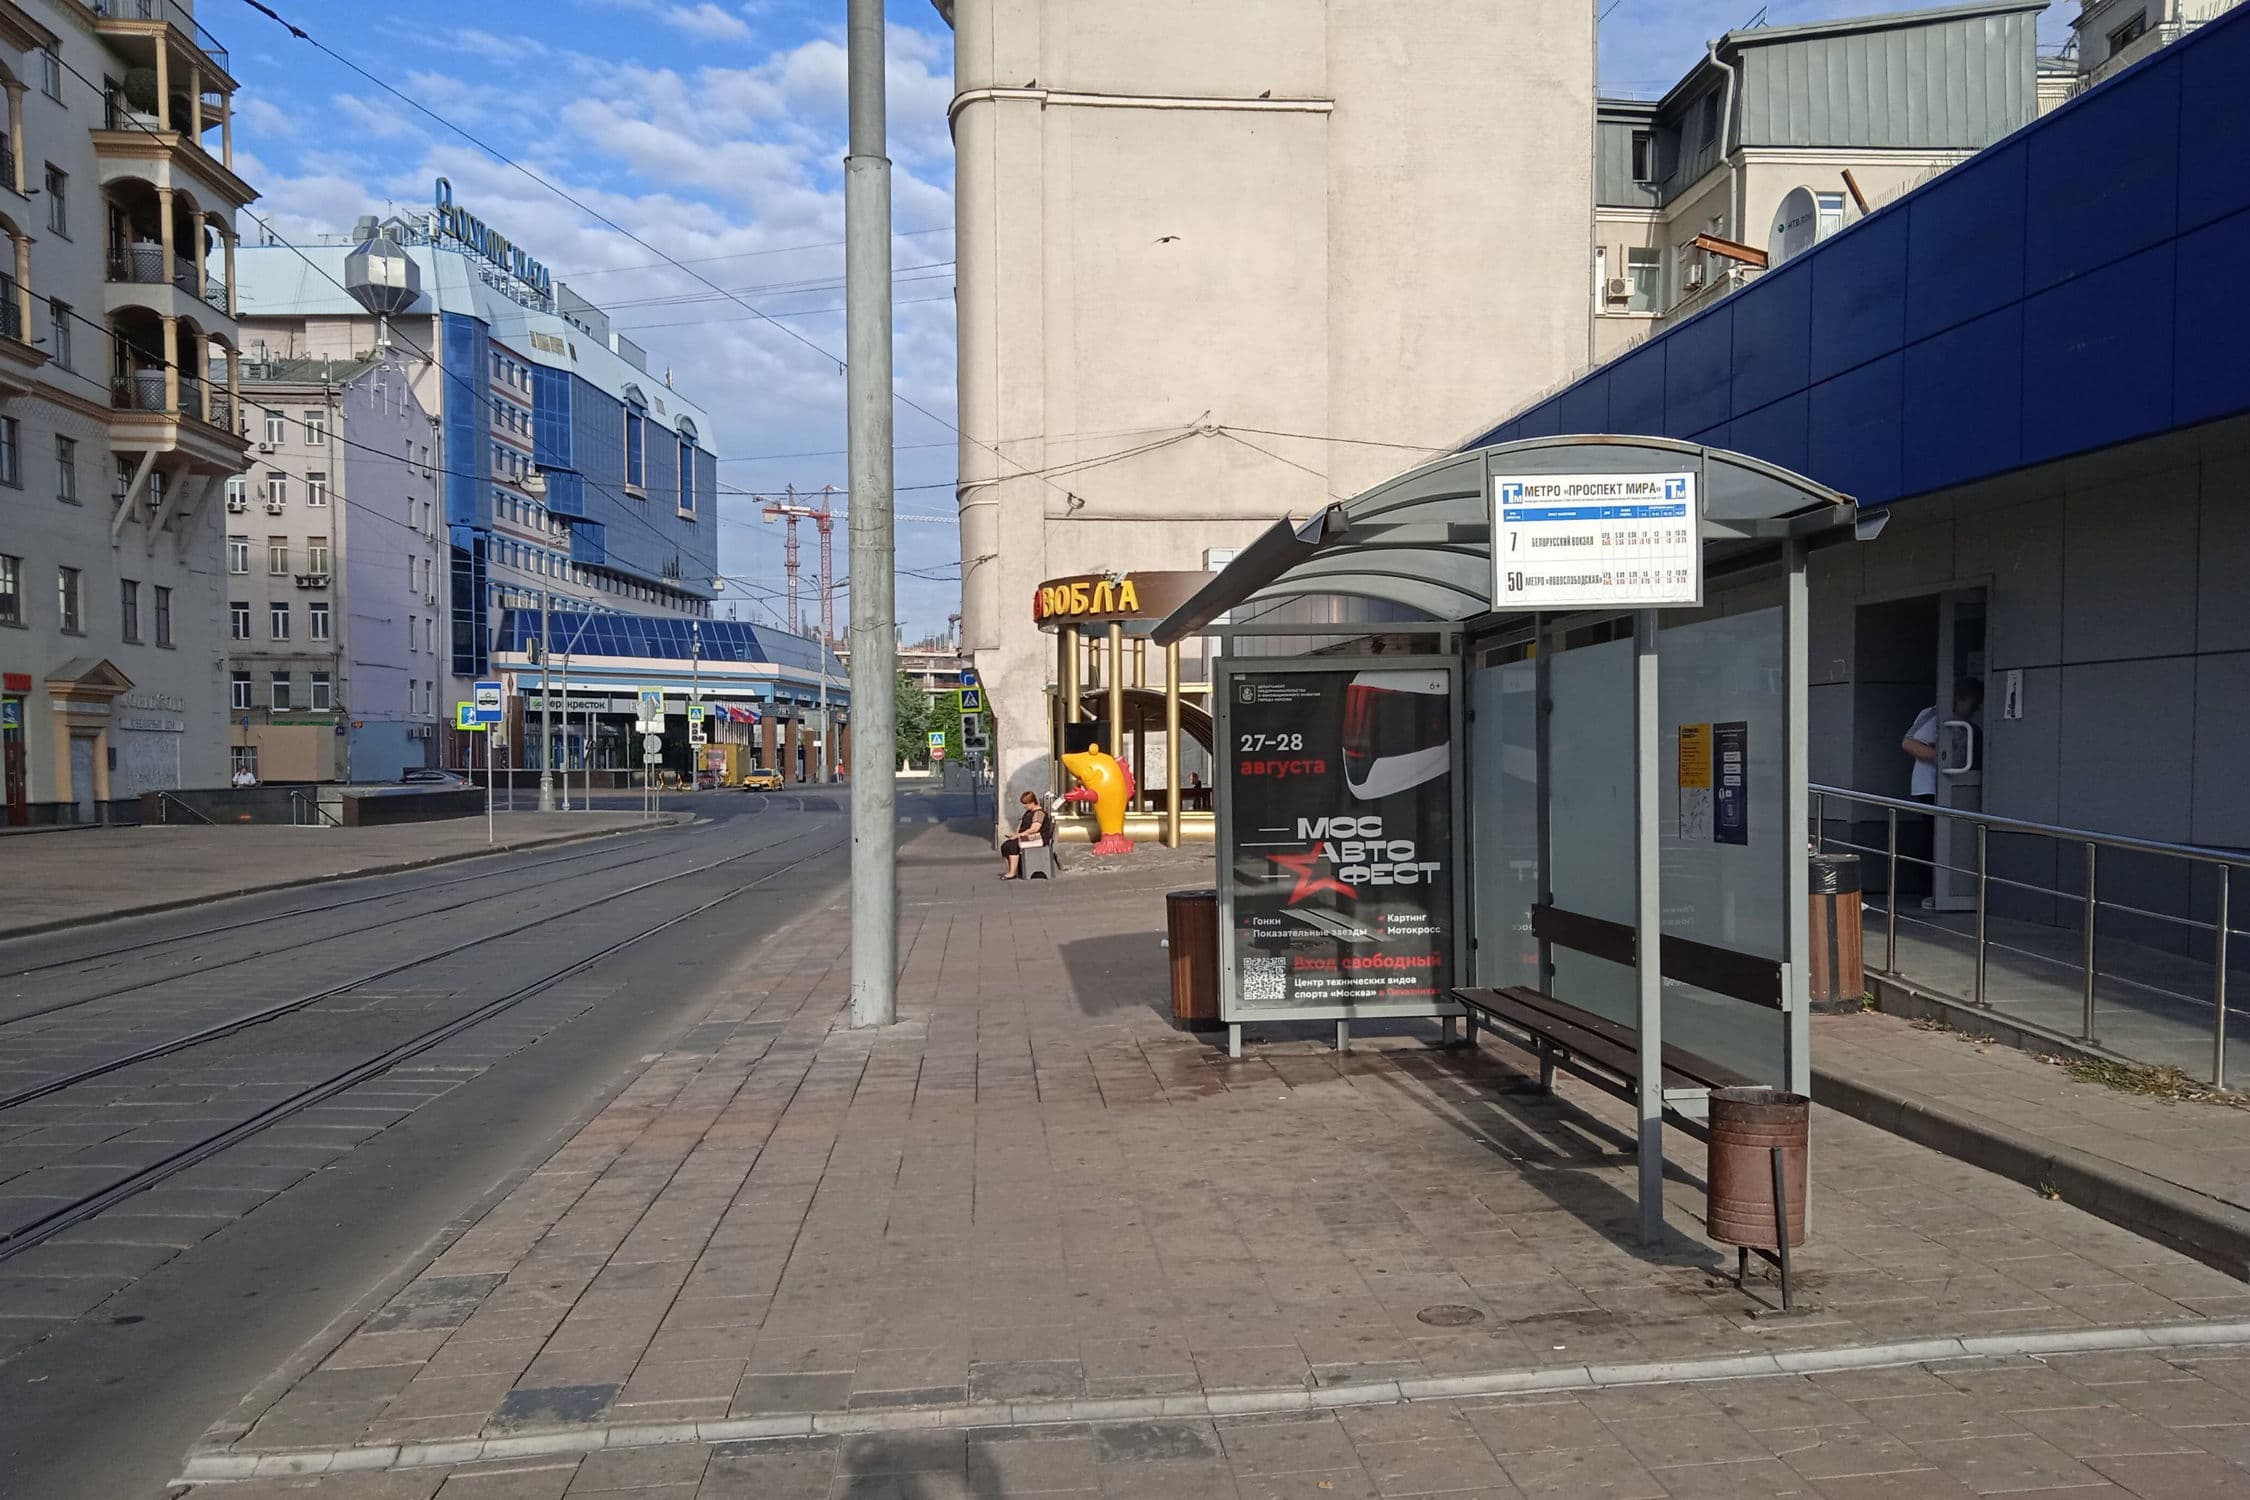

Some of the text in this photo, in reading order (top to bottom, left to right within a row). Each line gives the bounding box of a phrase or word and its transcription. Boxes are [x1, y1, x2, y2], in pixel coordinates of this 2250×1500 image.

[1524, 485, 1561, 497] МЕТРО
[1564, 483, 1623, 496] «ПРОСПЕКТ
[1625, 482, 1662, 494] МИРА»
[1510, 532, 1518, 551] 7
[1507, 571, 1524, 592] 50
[1525, 576, 1545, 586] МЕТРО
[1043, 580, 1140, 618] ВОБЛА
[1429, 682, 1440, 690] 6+
[1240, 758, 1327, 779] августа
[1297, 816, 1382, 840] МОС
[1317, 840, 1415, 863] АВТО
[1339, 862, 1441, 885] ФЕСТ
[1253, 917, 1281, 926] Гонки
[1387, 914, 1427, 924] Картинг
[1253, 929, 1368, 938] Показательные заезды
[1387, 926, 1441, 936] Мотокросс
[1294, 953, 1441, 972] Вход свободный
[1294, 976, 1417, 988] Центр технических видов
[1294, 991, 1328, 1000] спорта
[1330, 989, 1377, 999] «Москва»
